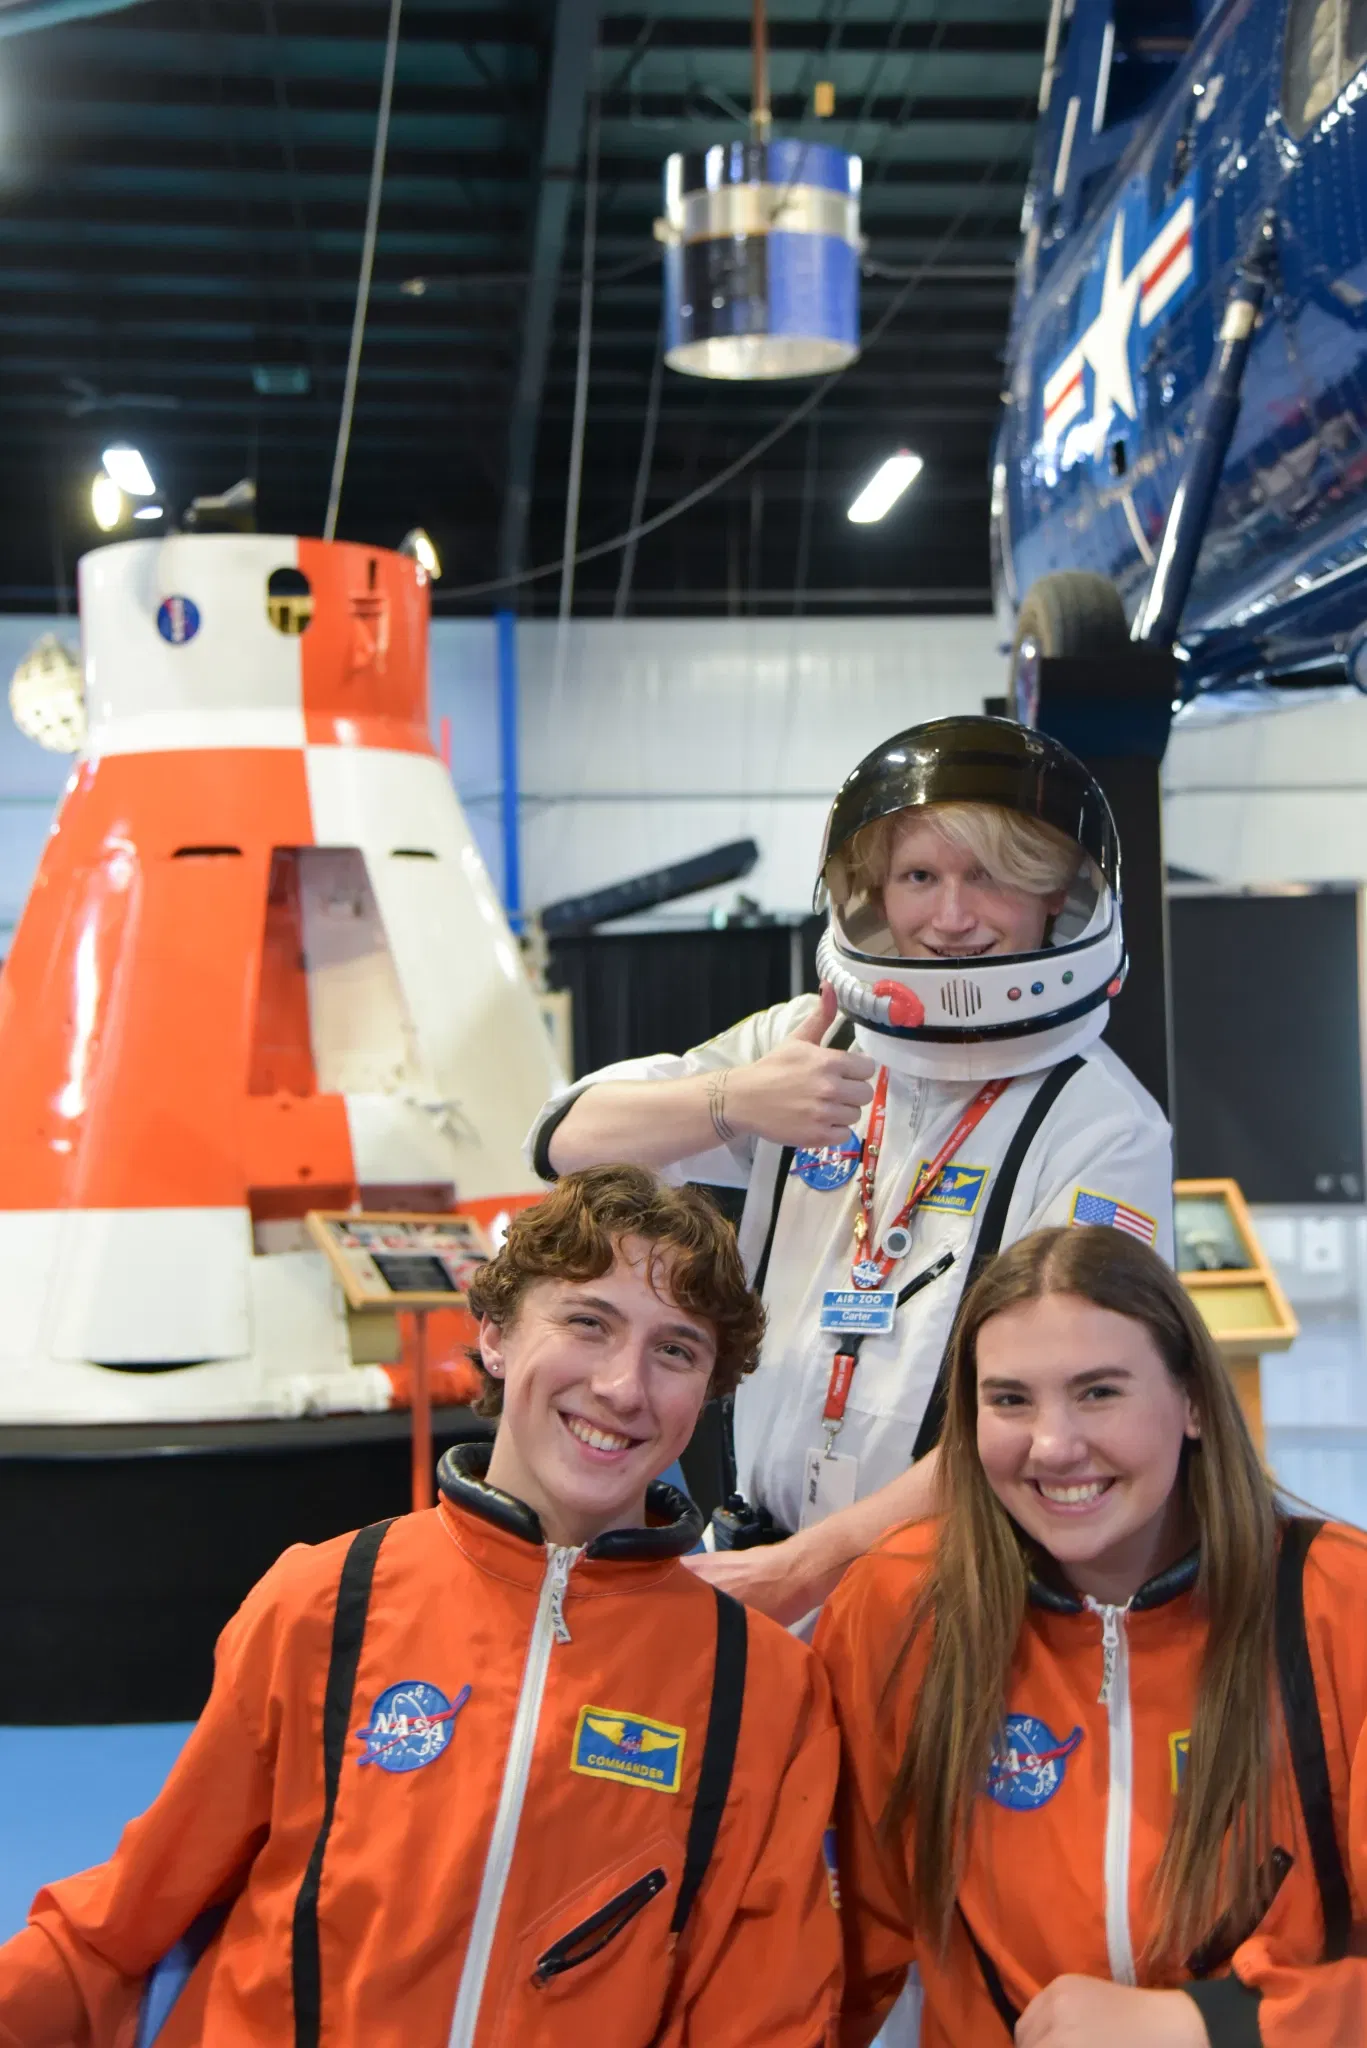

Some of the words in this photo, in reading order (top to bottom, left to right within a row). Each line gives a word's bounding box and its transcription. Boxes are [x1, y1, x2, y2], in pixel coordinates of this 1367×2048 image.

[836, 1294, 854, 1304] AIR
[858, 1294, 882, 1304] ZOO
[842, 1311, 872, 1321] Carter
[373, 1712, 446, 1742] NASA
[587, 1753, 664, 1780] COMMANDER
